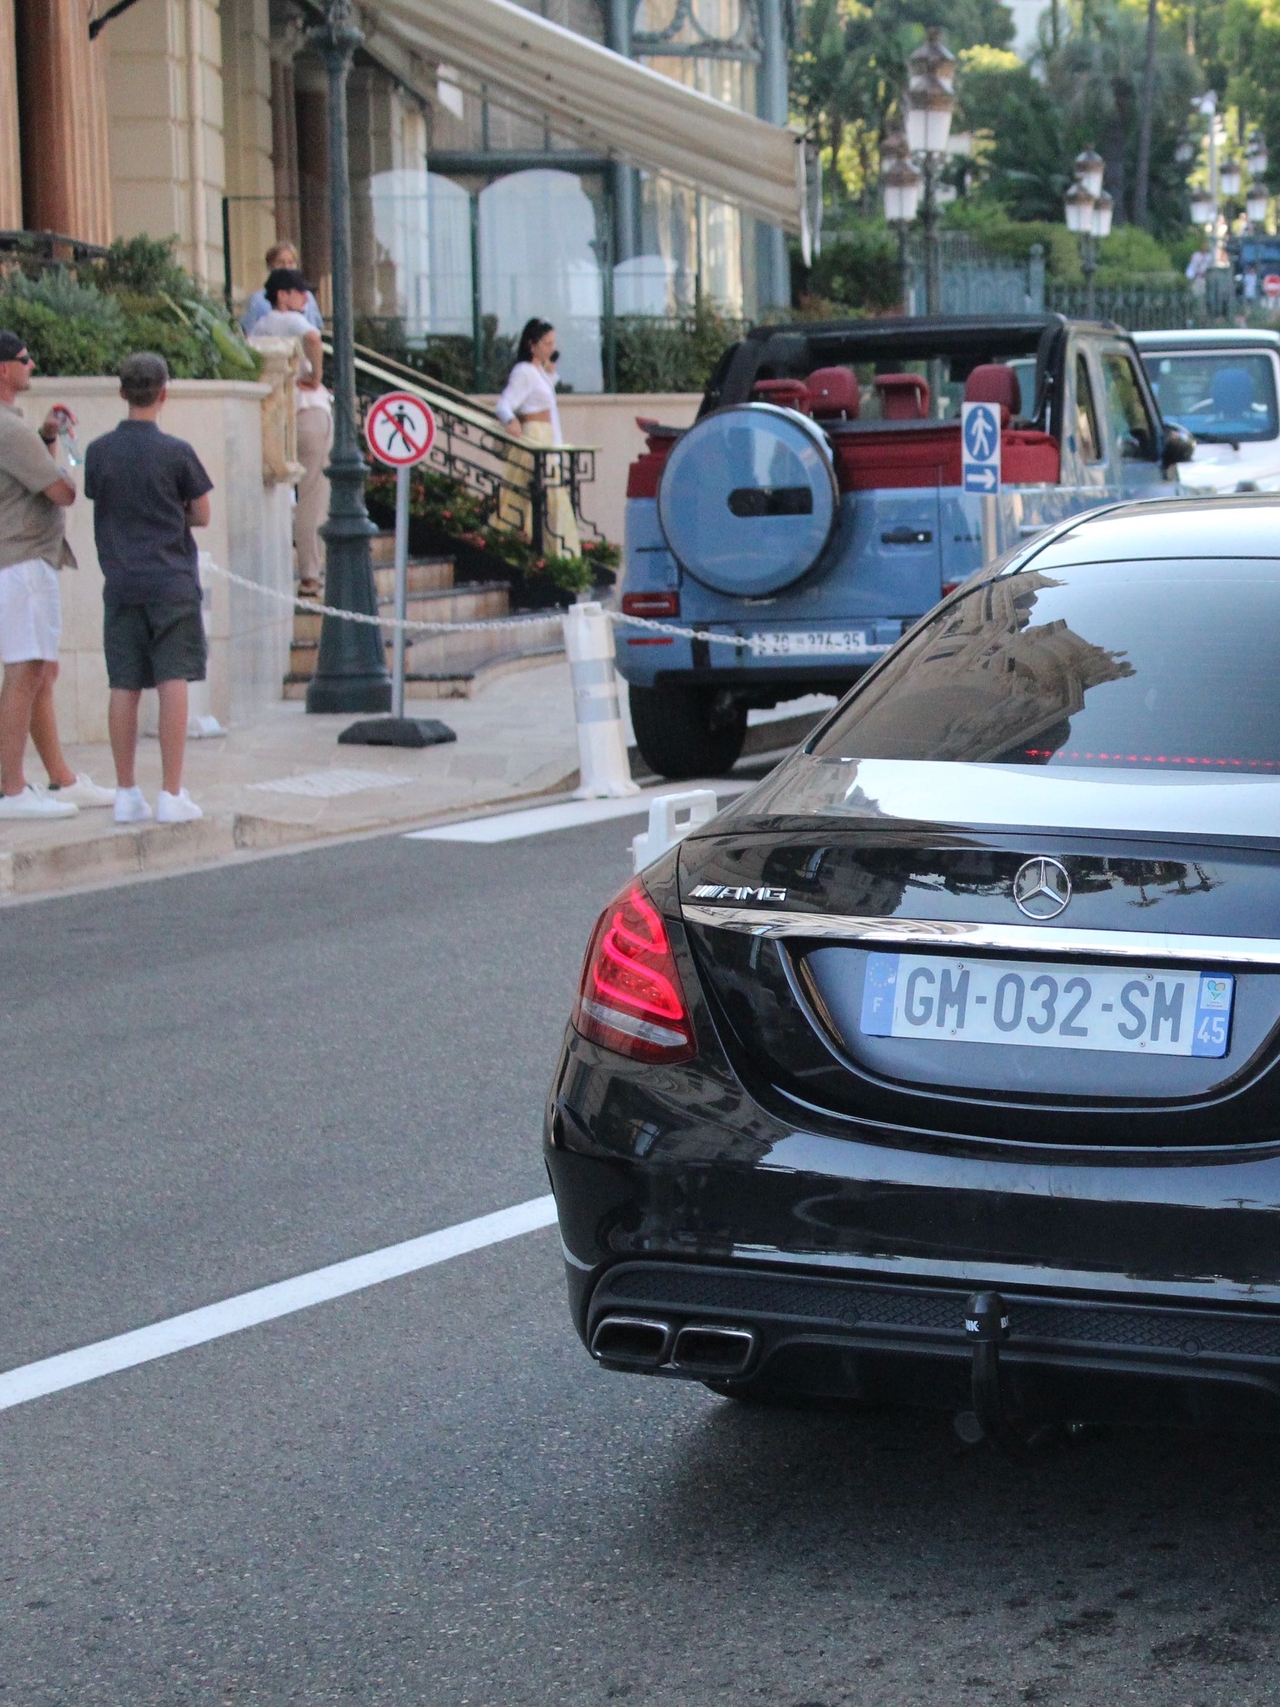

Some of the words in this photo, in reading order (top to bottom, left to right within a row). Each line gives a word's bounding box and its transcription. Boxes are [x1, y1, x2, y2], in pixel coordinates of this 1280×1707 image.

[716, 886, 787, 901] AMG
[873, 996, 884, 1013] F
[904, 966, 1185, 1043] GM-032-SM
[1197, 1016, 1226, 1044] 45
